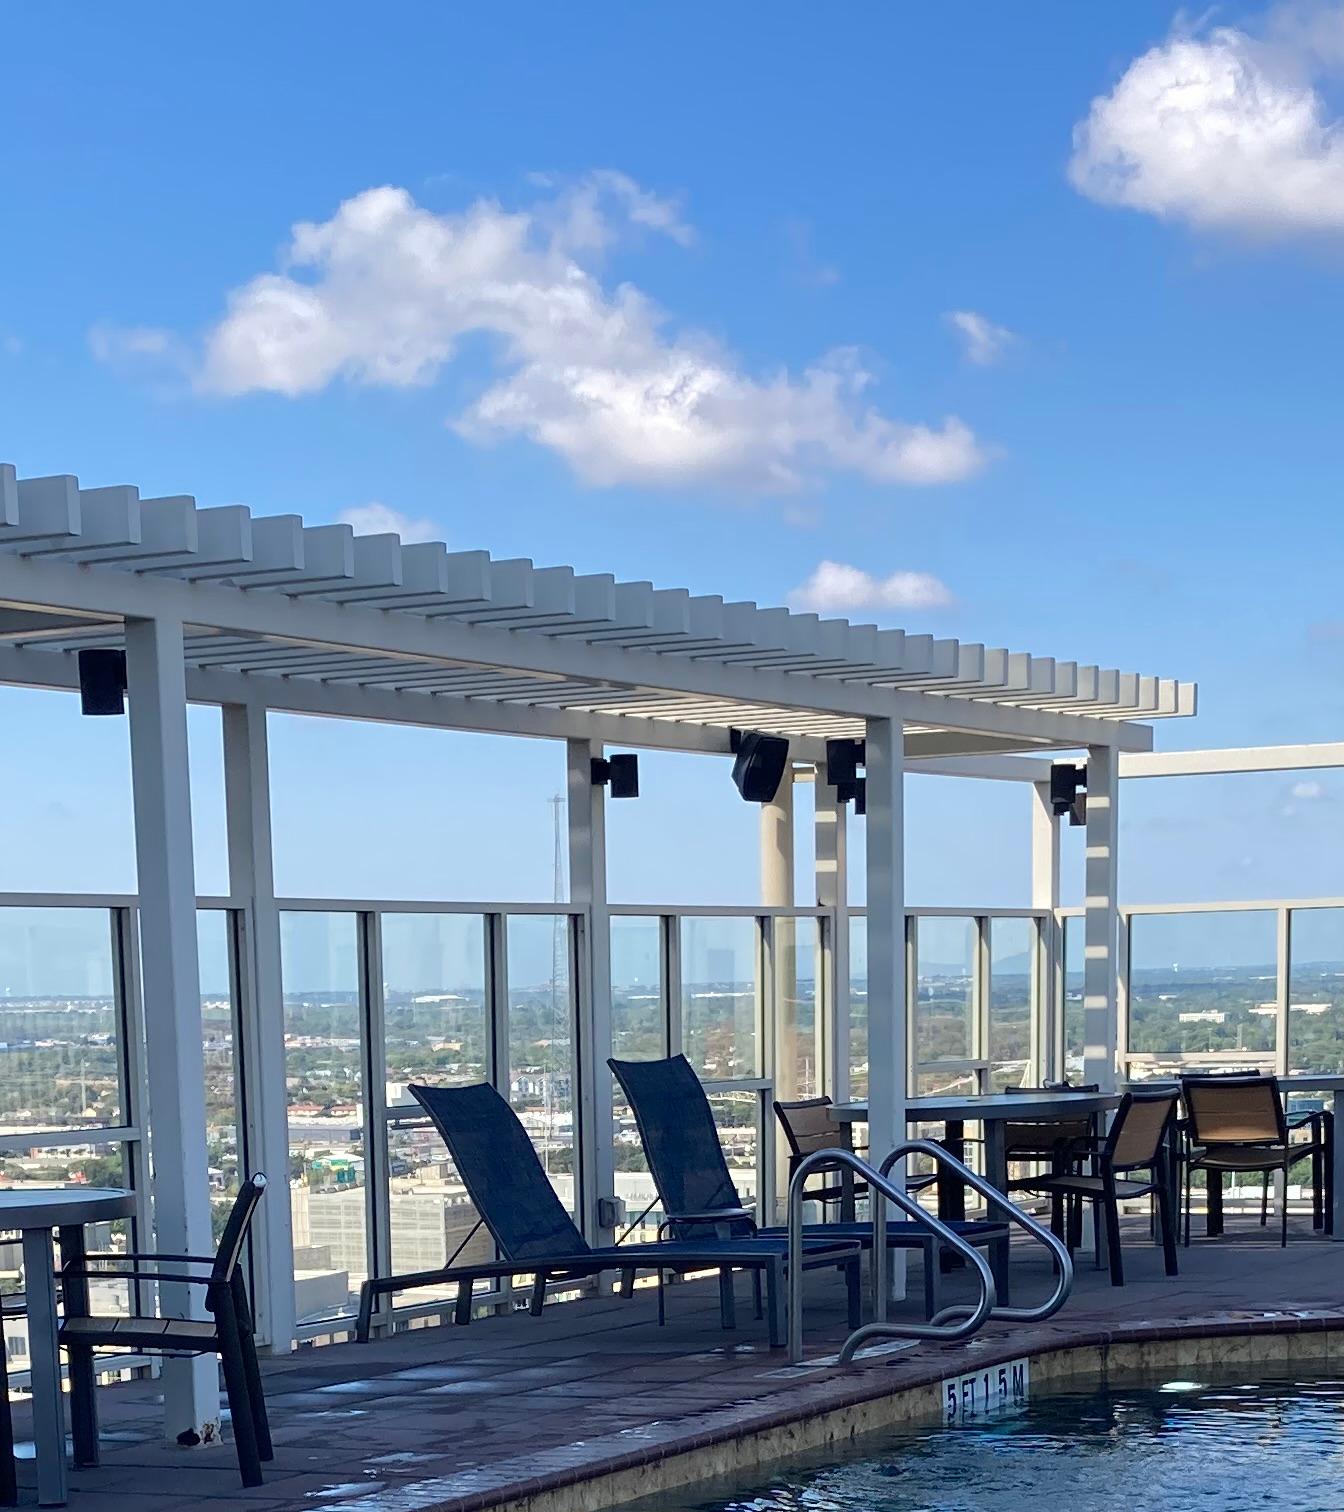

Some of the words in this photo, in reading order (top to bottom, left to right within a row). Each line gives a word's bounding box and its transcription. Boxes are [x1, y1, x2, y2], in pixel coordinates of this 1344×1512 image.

[947, 1384, 957, 1415] 5
[961, 1377, 977, 1408] FT
[984, 1373, 990, 1405] 1
[998, 1368, 1008, 1400] 5
[1012, 1363, 1025, 1397] M
